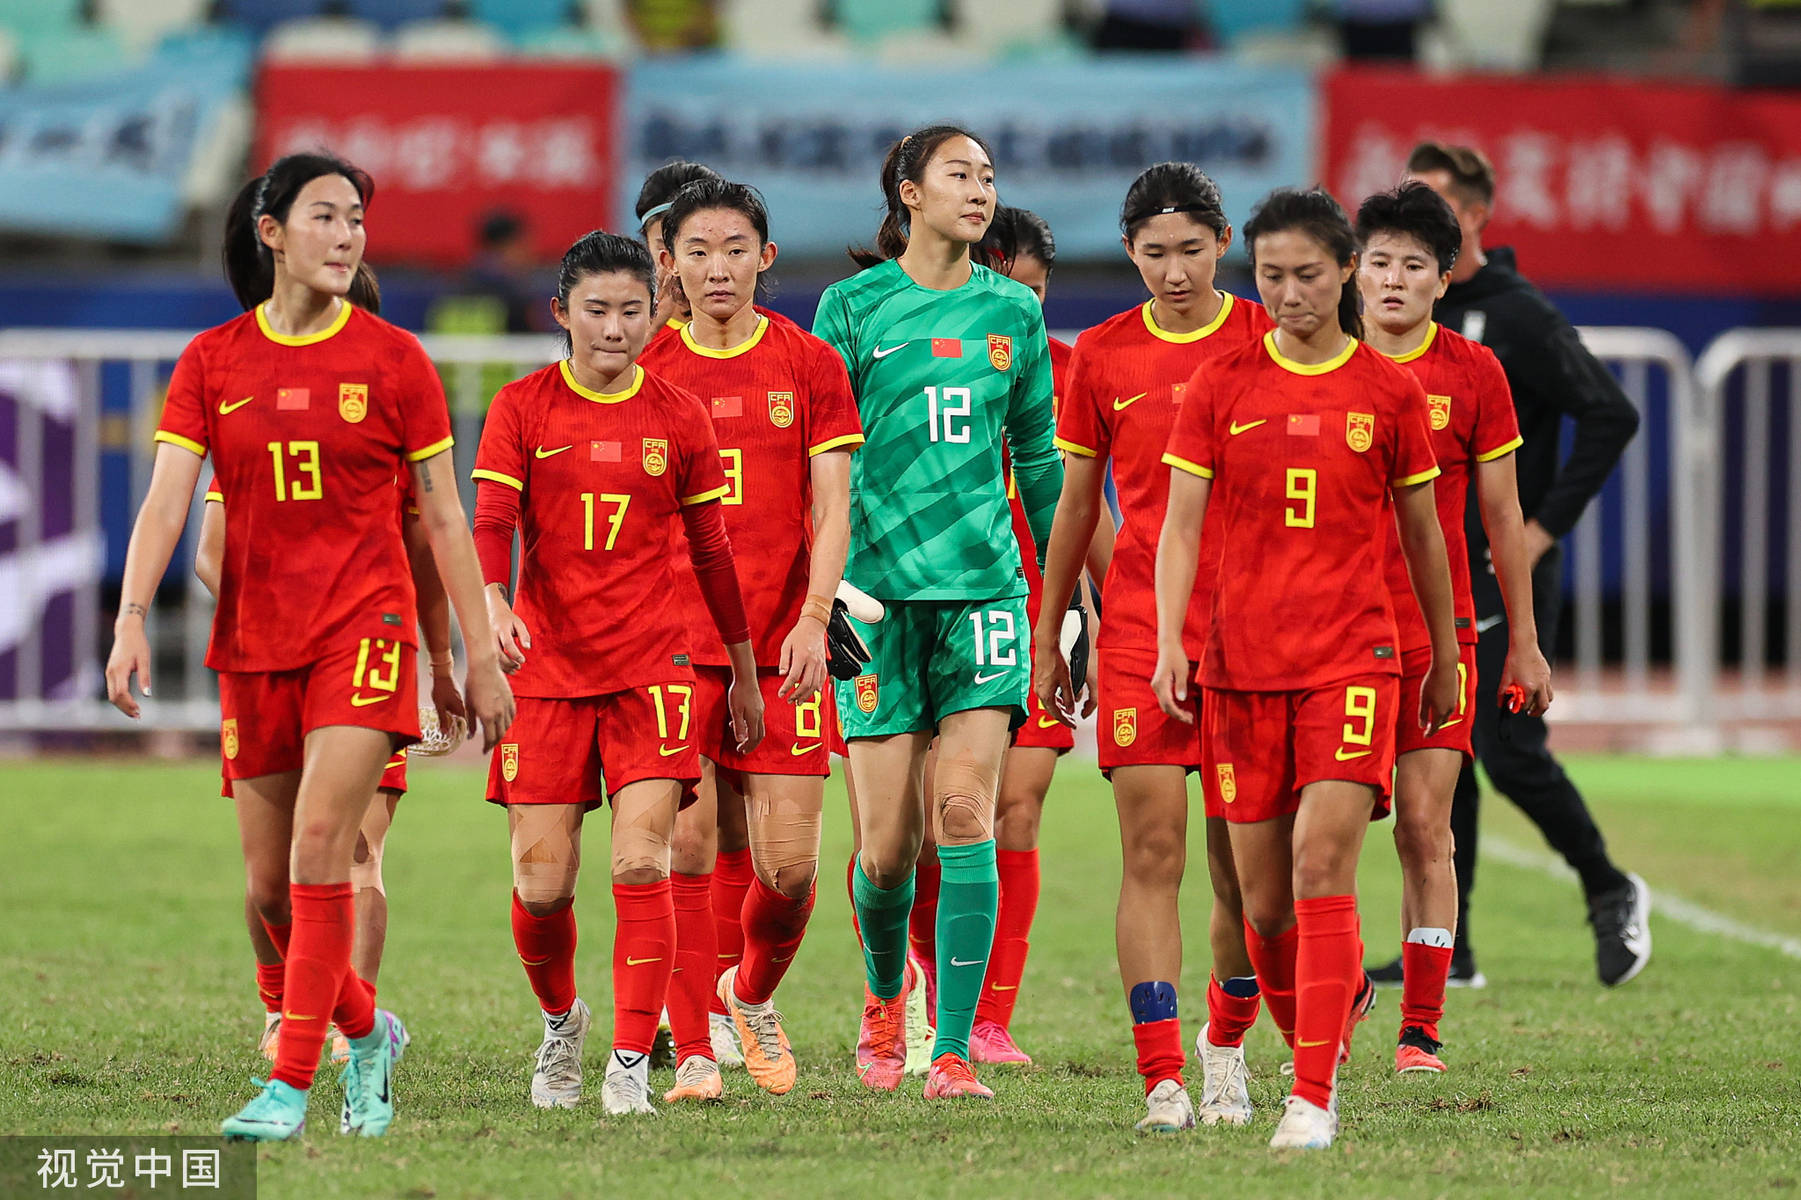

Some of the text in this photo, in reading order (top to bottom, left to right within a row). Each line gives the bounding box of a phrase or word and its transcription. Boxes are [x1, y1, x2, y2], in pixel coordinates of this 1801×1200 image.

[990, 337, 1009, 346] CFA
[925, 387, 971, 443] 12
[268, 442, 322, 502] 13
[645, 441, 666, 450] CFA
[580, 493, 631, 551] 17
[1285, 468, 1317, 529] 9
[352, 639, 401, 692] 13
[969, 610, 1017, 666] 12
[648, 685, 692, 740] 17
[796, 683, 822, 738] 8
[1342, 686, 1376, 746] 9
